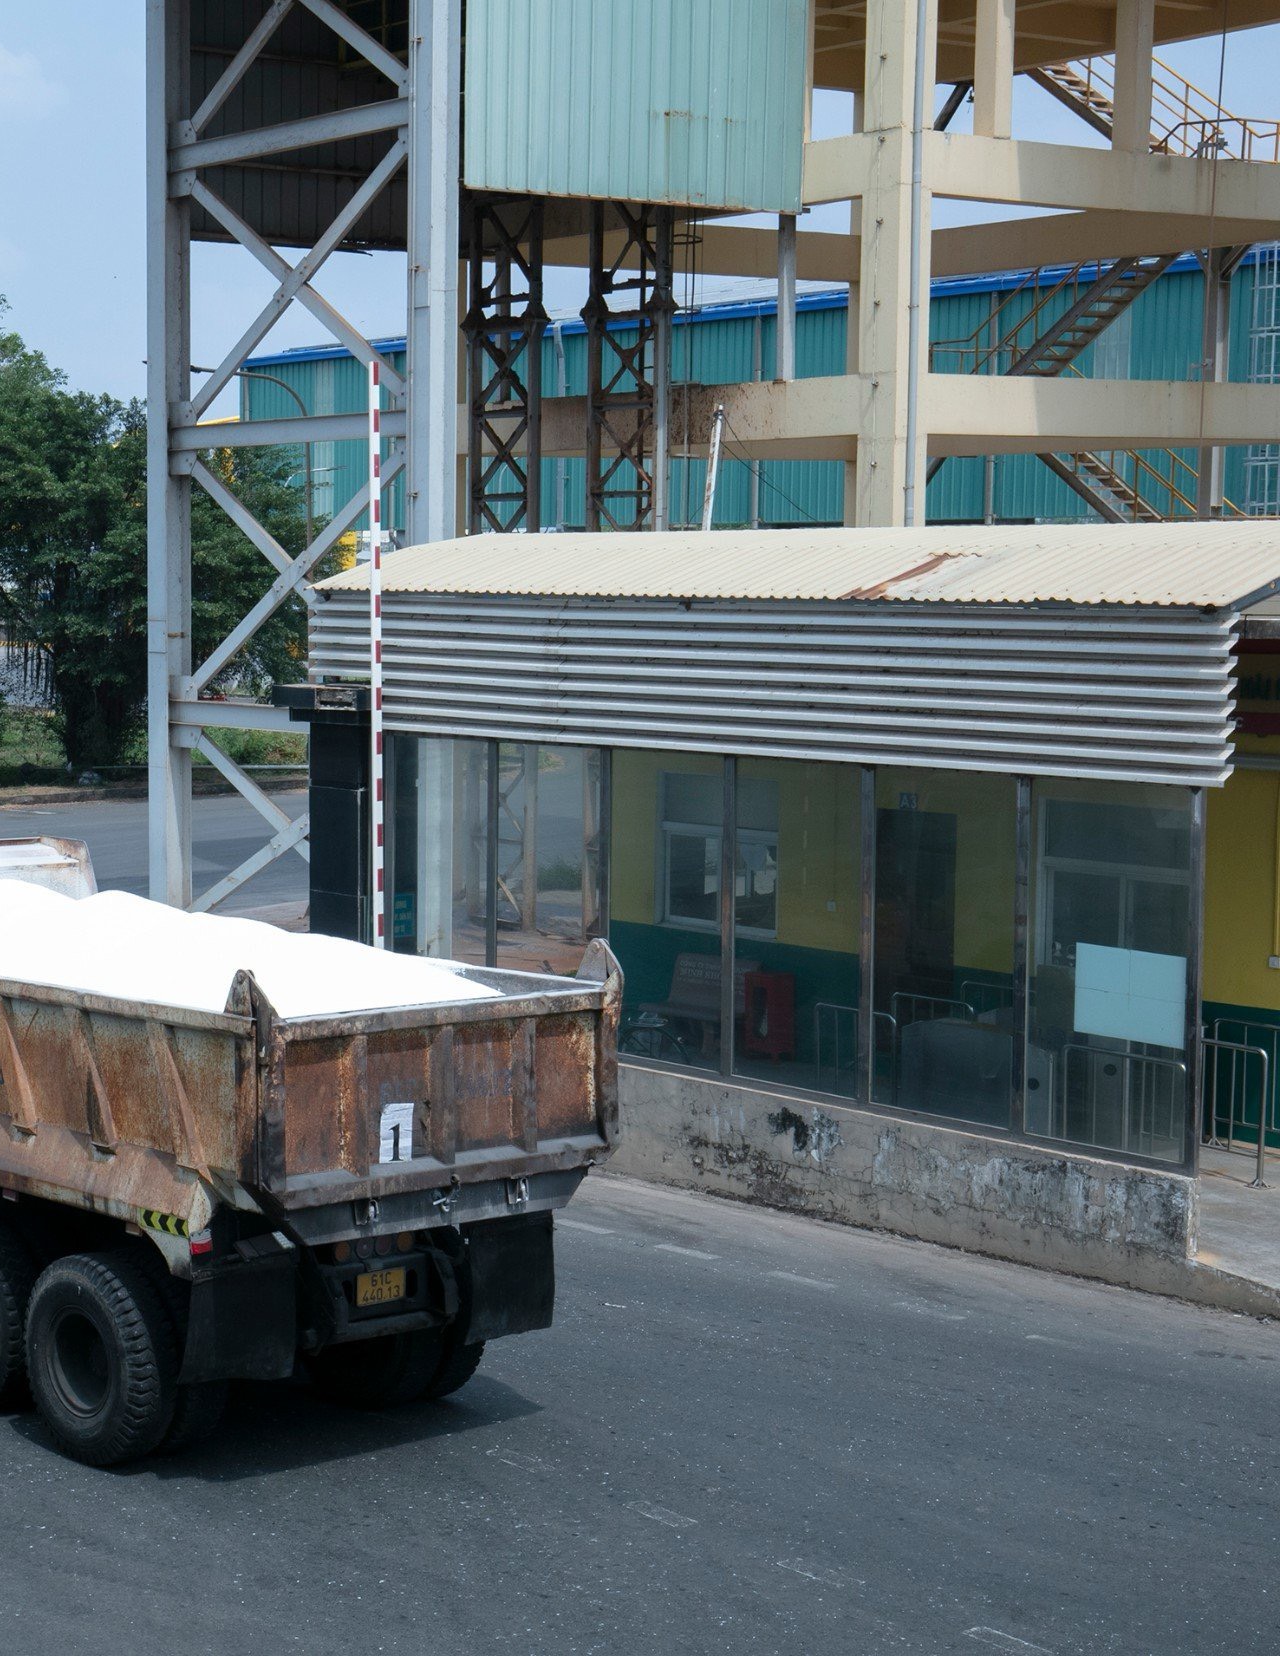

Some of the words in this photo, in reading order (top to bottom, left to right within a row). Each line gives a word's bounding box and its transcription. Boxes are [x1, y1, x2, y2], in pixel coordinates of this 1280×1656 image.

[388, 1122, 405, 1162] 1
[371, 1272, 393, 1287] 61C
[362, 1284, 400, 1303] 440.13
